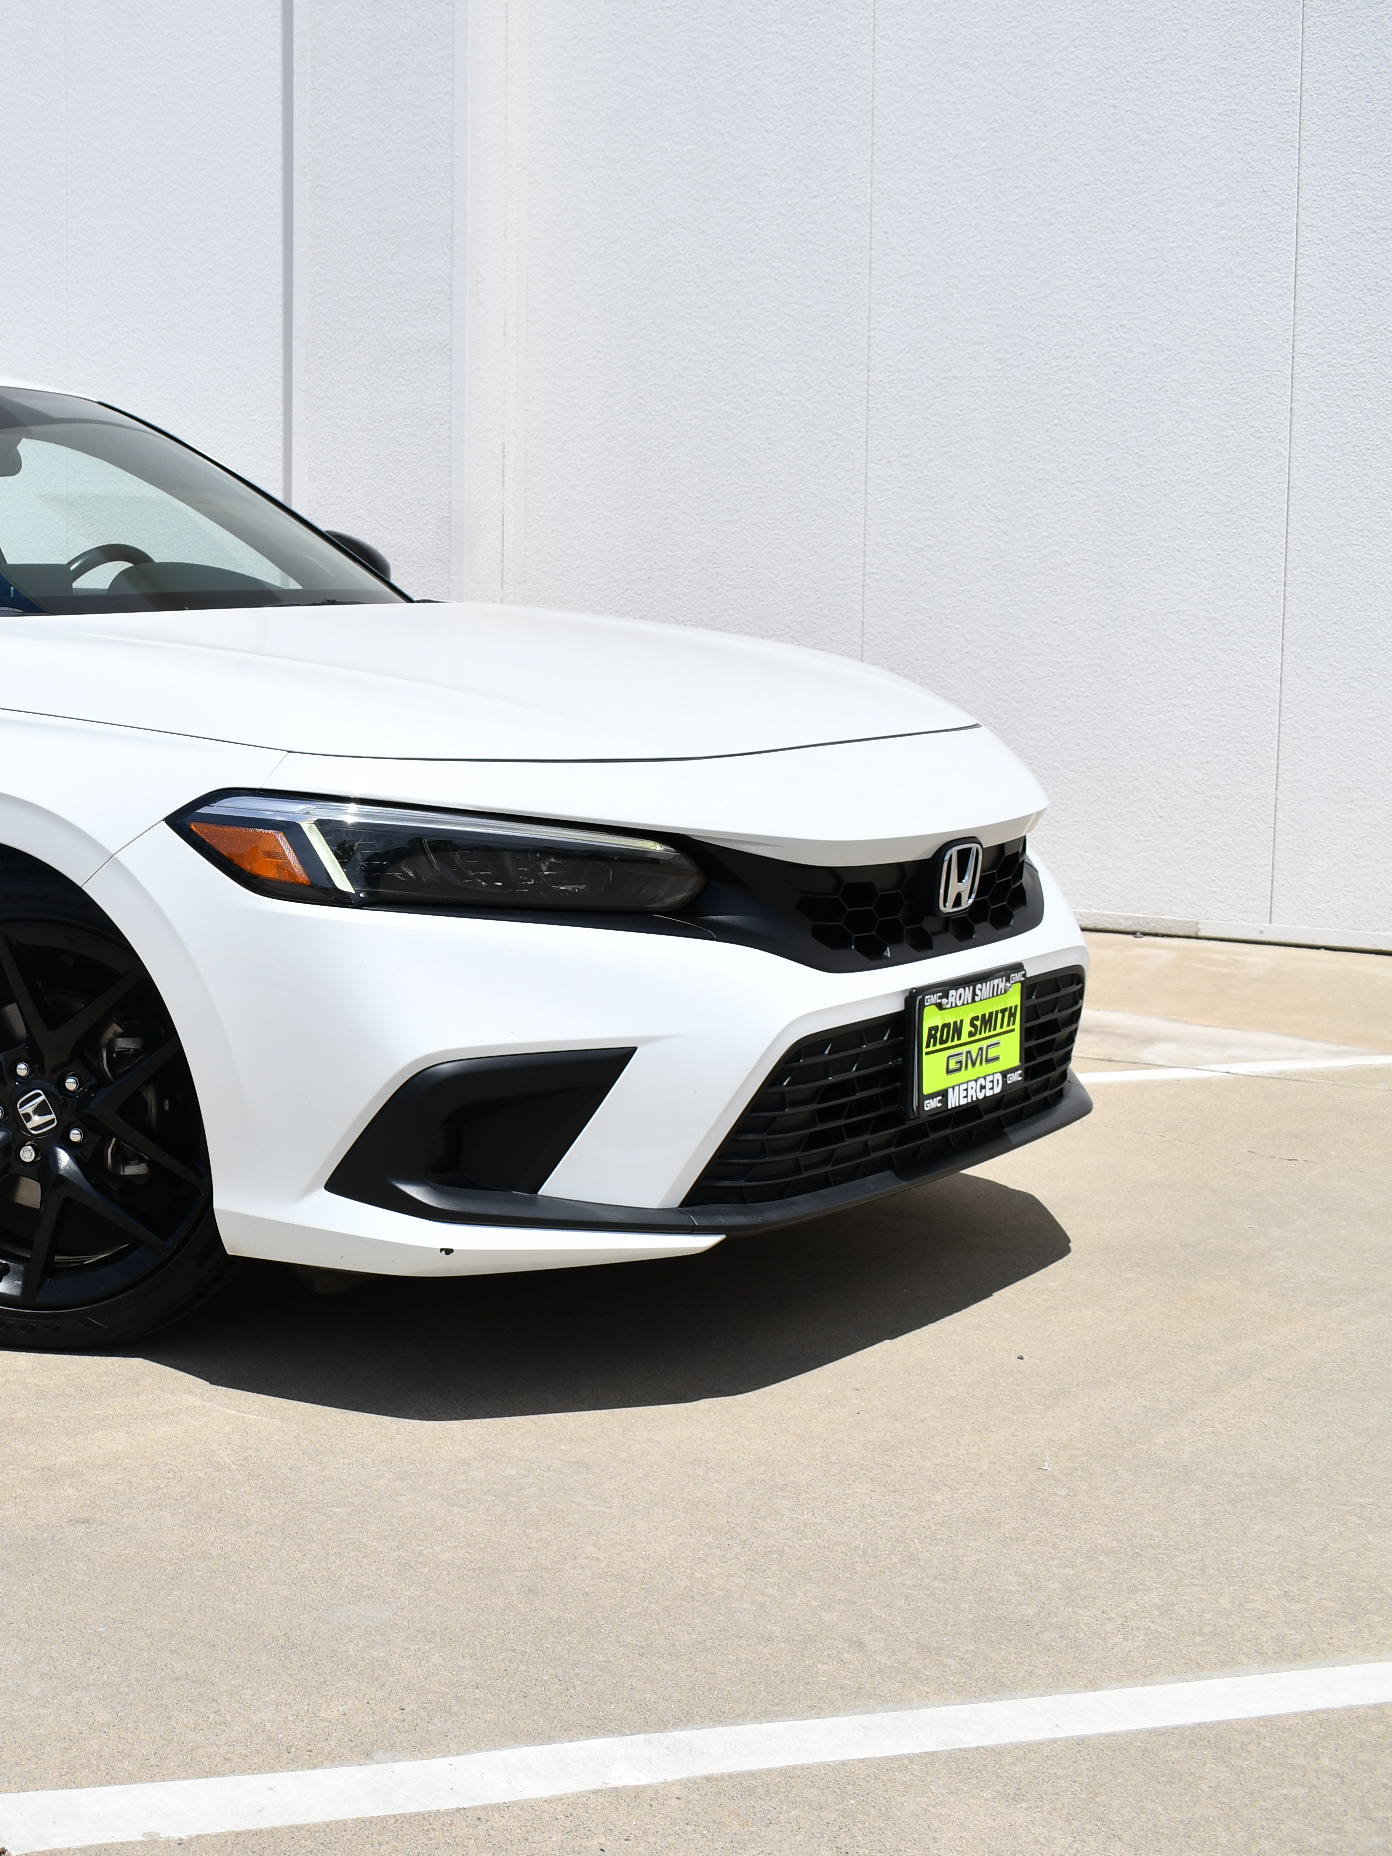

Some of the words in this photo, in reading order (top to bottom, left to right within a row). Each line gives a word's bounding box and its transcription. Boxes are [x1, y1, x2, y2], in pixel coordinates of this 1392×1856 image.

[948, 986, 973, 1008] RON
[975, 977, 1006, 1001] SMITH
[925, 1019, 964, 1049] RON
[968, 1004, 1018, 1038] SMITH
[946, 1041, 1000, 1074] GMC
[947, 1072, 1003, 1110] MERCED
